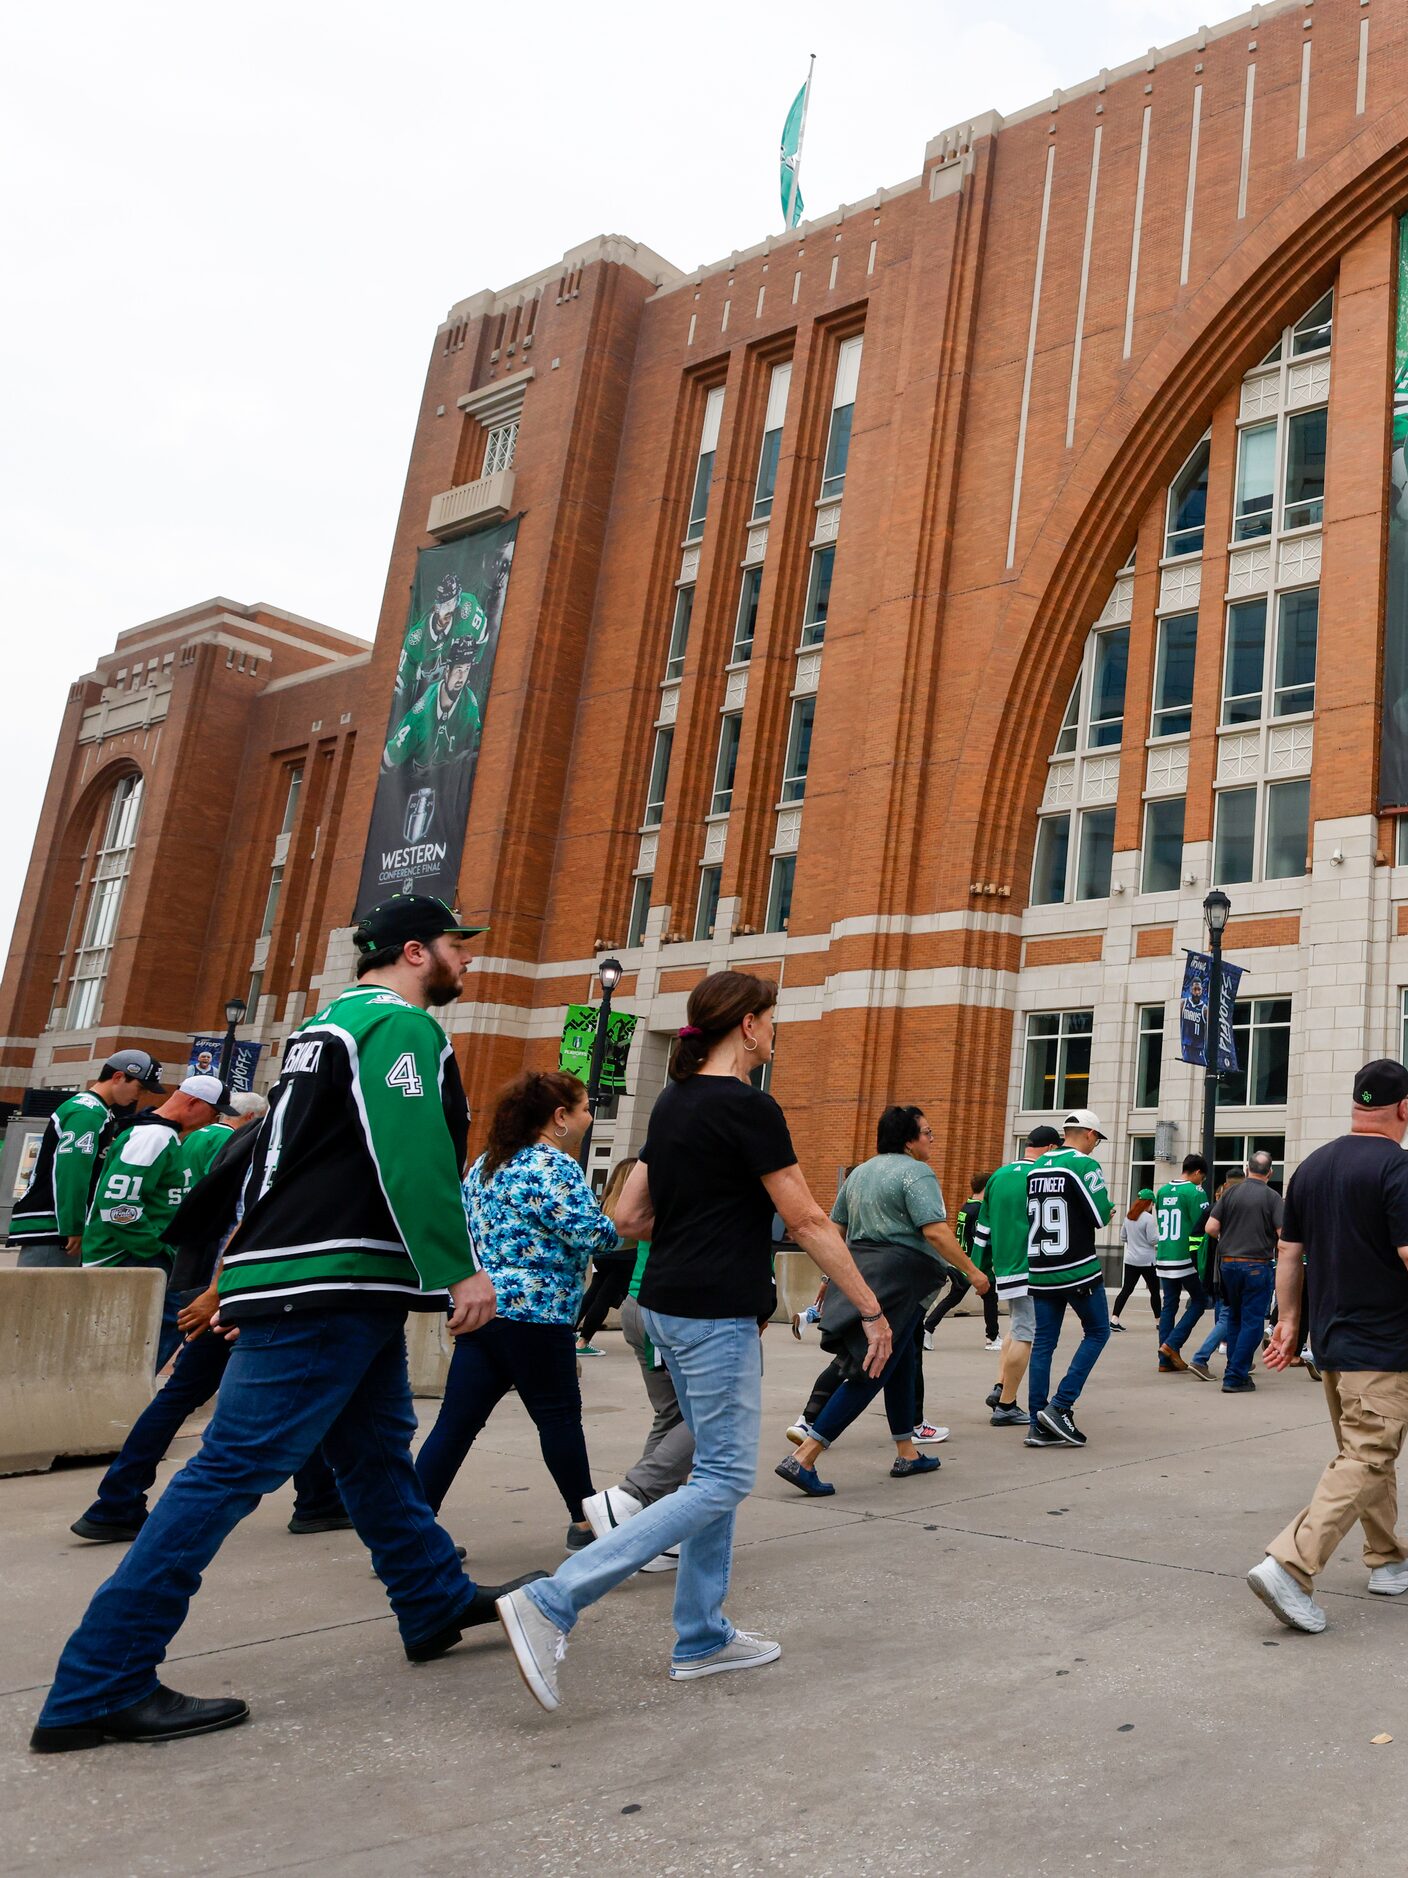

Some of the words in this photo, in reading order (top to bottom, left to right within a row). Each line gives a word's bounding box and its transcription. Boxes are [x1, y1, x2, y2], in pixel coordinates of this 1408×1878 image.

[379, 866, 421, 882] CONFERENCE
[422, 862, 441, 874] FINAL
[382, 841, 447, 871] WESTERN
[1219, 972, 1233, 1054] PLAYOFFS
[231, 1047, 253, 1094] PLAYOFFS
[384, 1052, 425, 1098] 4
[58, 1130, 95, 1155] 24
[103, 1173, 144, 1202] 91
[1027, 1196, 1070, 1257] 29
[1157, 1208, 1182, 1242] 30
